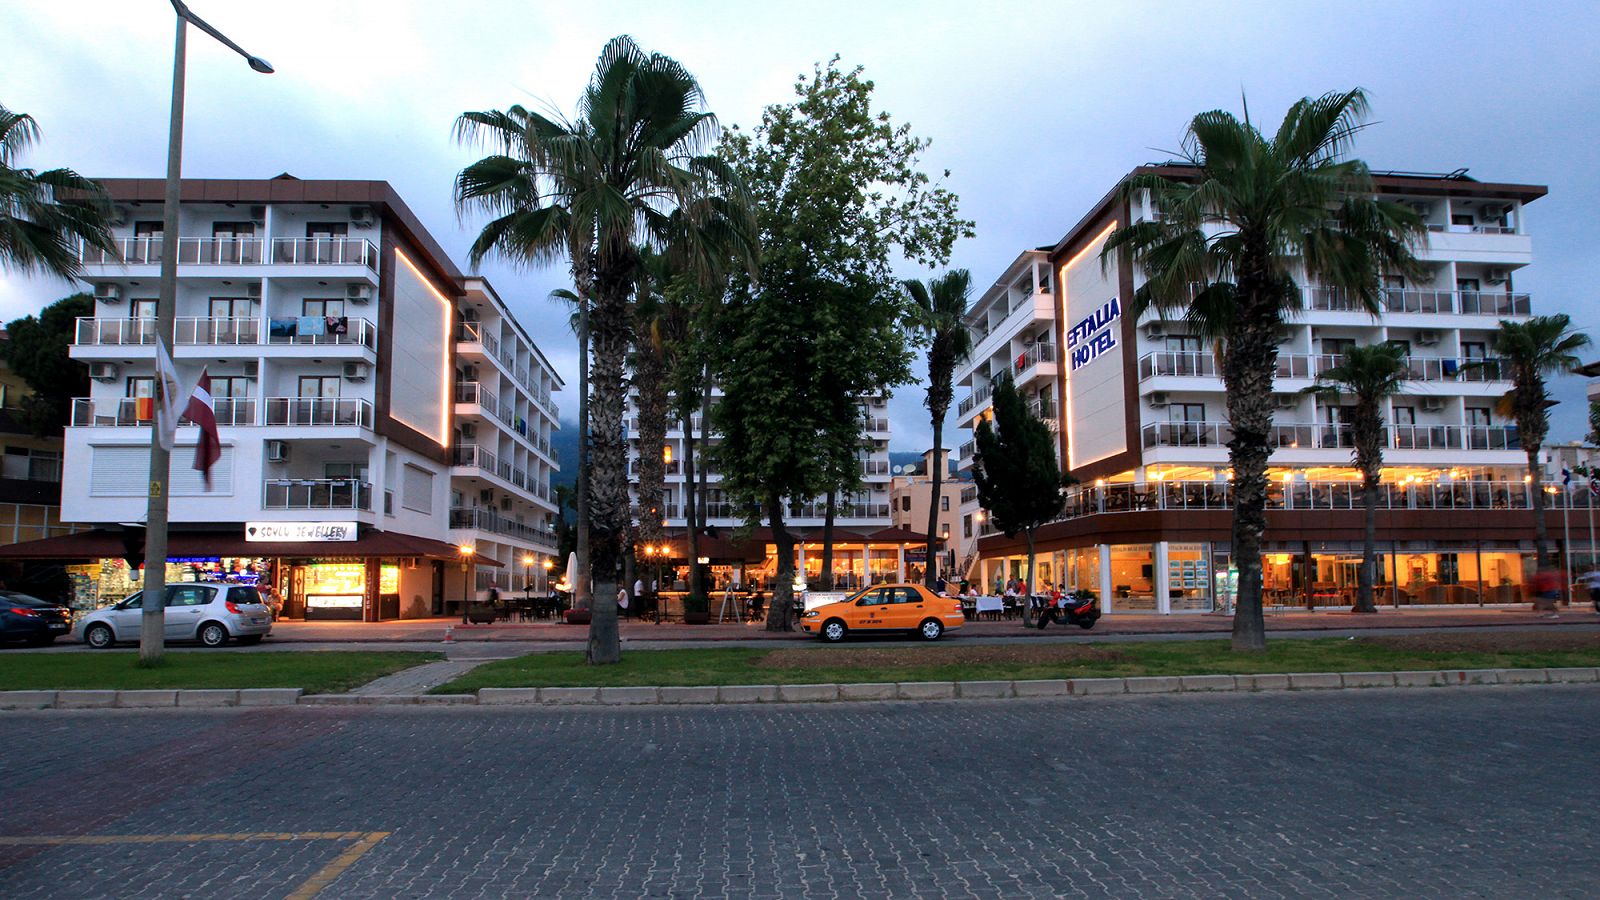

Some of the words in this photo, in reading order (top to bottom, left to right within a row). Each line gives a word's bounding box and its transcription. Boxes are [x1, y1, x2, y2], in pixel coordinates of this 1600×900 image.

[1067, 297, 1121, 350] EFTALIA
[1071, 328, 1118, 371] HOTEL
[296, 526, 348, 539] JEWELLERY
